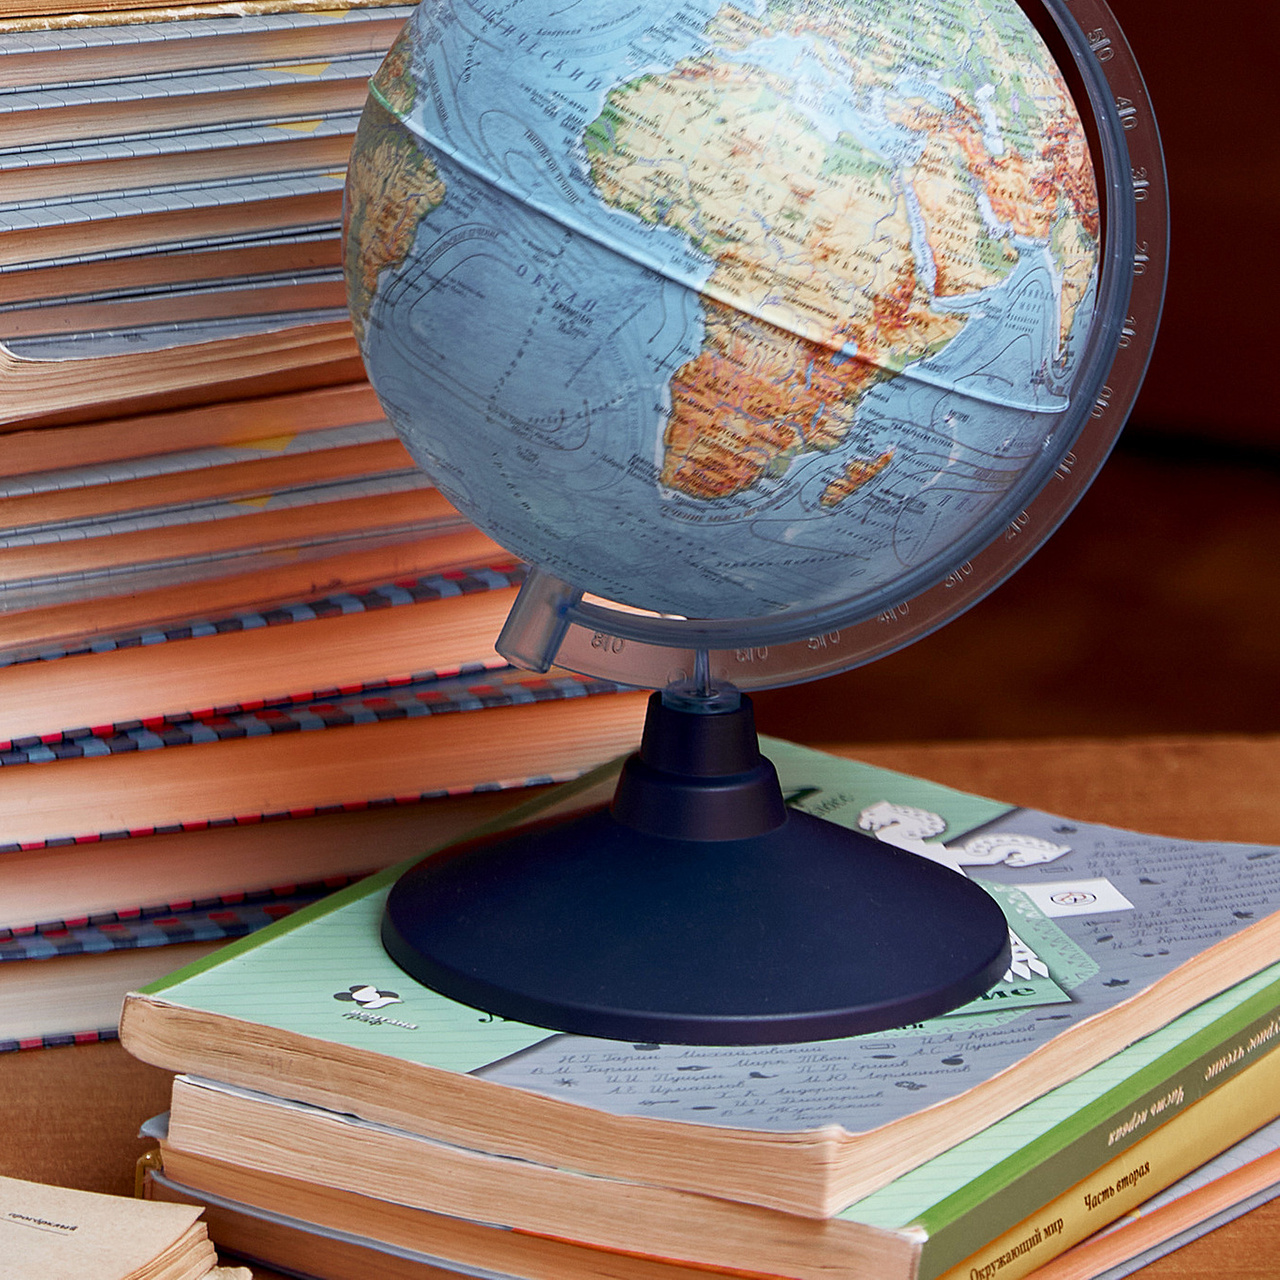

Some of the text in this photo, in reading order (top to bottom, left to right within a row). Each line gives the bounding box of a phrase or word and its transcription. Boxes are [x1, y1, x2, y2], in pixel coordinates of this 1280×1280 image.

[1150, 1085, 1185, 1118] Часть
[1108, 1107, 1149, 1146] первая
[969, 1160, 1151, 1280] Окружающий мир Часть вторая
